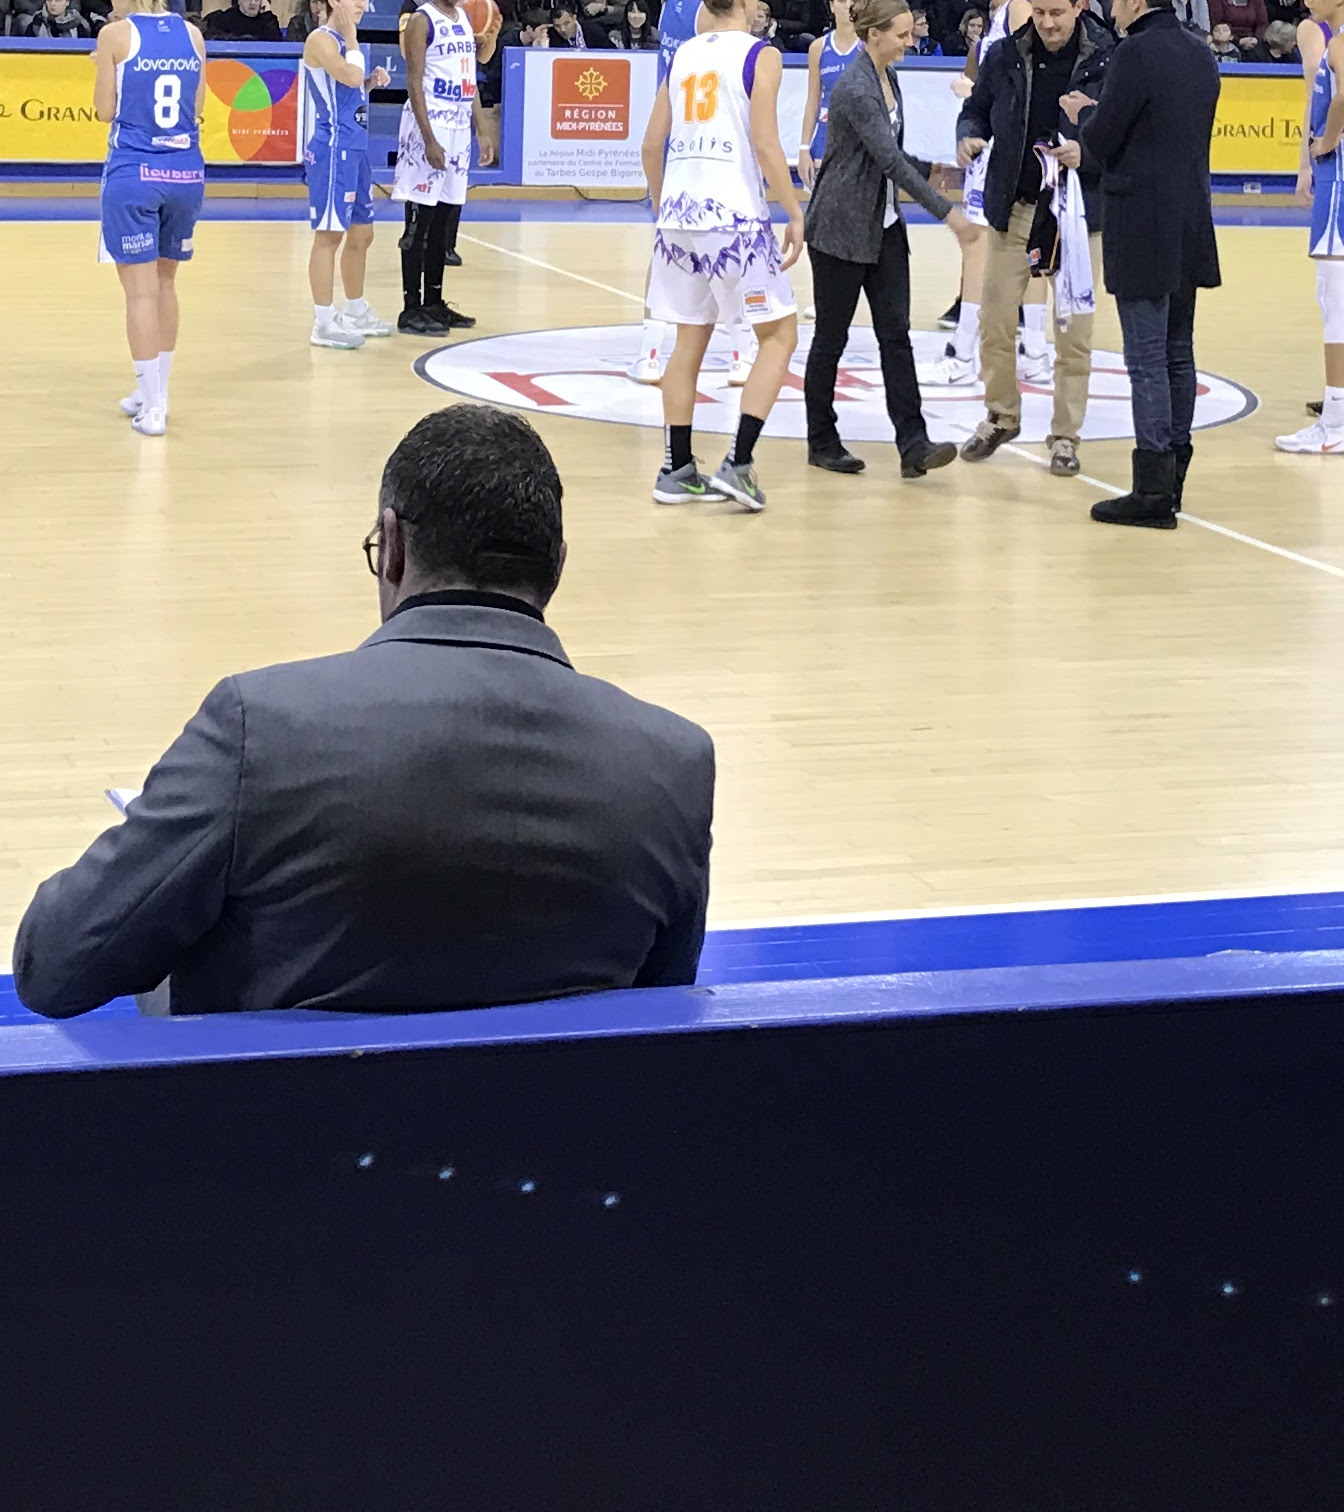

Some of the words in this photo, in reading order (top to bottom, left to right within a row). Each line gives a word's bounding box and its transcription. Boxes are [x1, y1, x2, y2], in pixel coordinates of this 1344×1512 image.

[133, 56, 200, 73] Jovanovic
[385, 55, 397, 73] L
[459, 56, 470, 73] 11
[153, 74, 181, 129] 8
[679, 69, 721, 125] 13
[564, 108, 616, 119] RÉGION
[556, 120, 623, 131] MIDI-PYRÉNÉES
[576, 148, 640, 159] Midi-Pyrénées
[546, 168, 576, 176] Tarbes
[579, 169, 608, 178] Gespe
[610, 169, 643, 178] Bigorre
